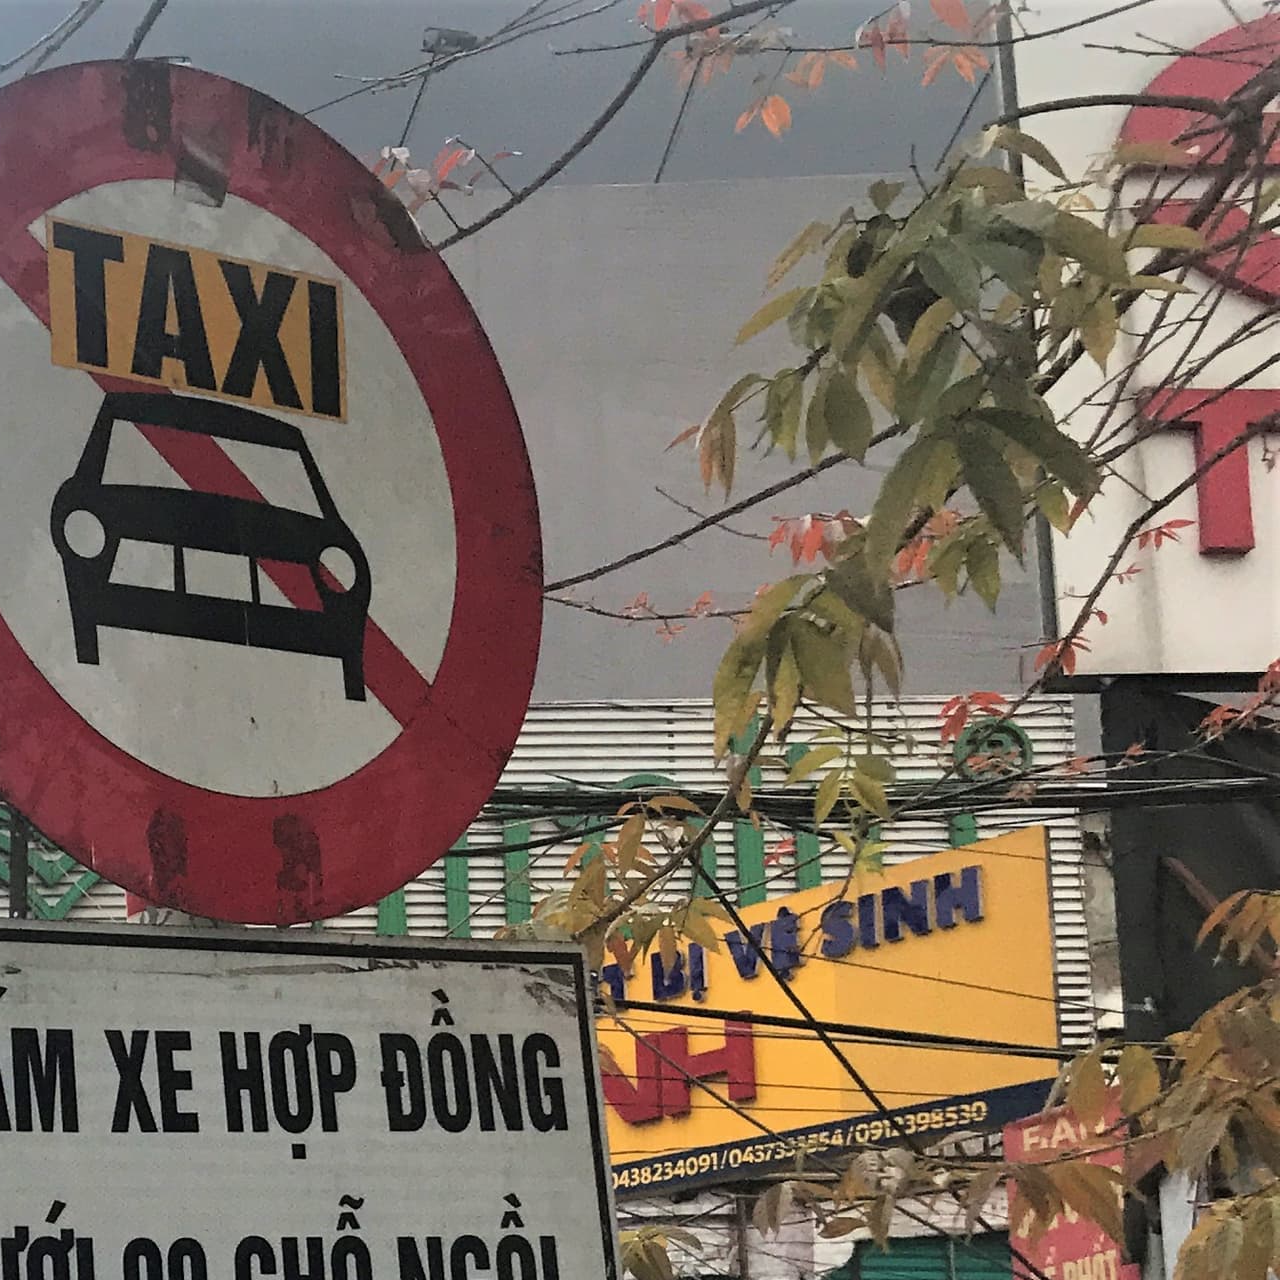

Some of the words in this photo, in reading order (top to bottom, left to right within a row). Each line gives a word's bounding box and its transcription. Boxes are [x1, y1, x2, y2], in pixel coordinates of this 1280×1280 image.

[51, 219, 344, 419] TAXI
[725, 906, 806, 981] VỆ
[820, 865, 985, 959] SINH
[105, 1028, 200, 1133] XE
[218, 1023, 357, 1160] HỢP
[379, 988, 569, 1133] ĐỒNG
